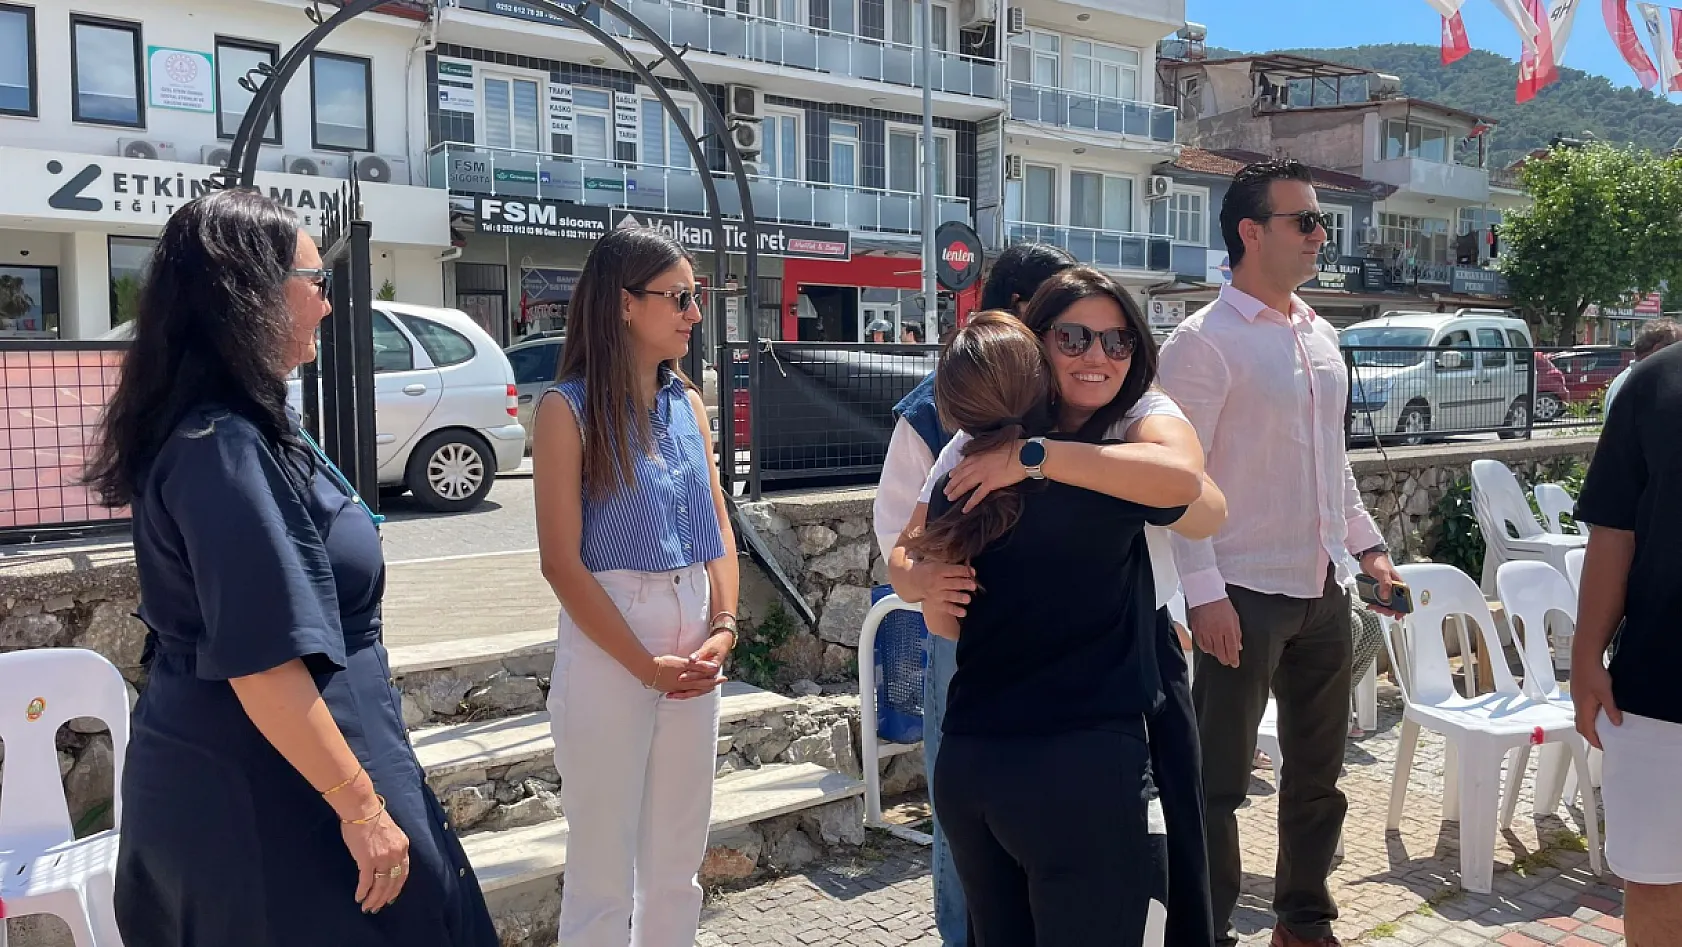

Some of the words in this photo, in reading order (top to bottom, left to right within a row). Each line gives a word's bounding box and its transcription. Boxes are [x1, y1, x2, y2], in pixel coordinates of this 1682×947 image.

[549, 104, 572, 113] KASKO
[455, 159, 485, 172] FSM
[481, 199, 557, 226] FSM
[647, 217, 713, 245] Volkan
[722, 224, 786, 251] Ticret
